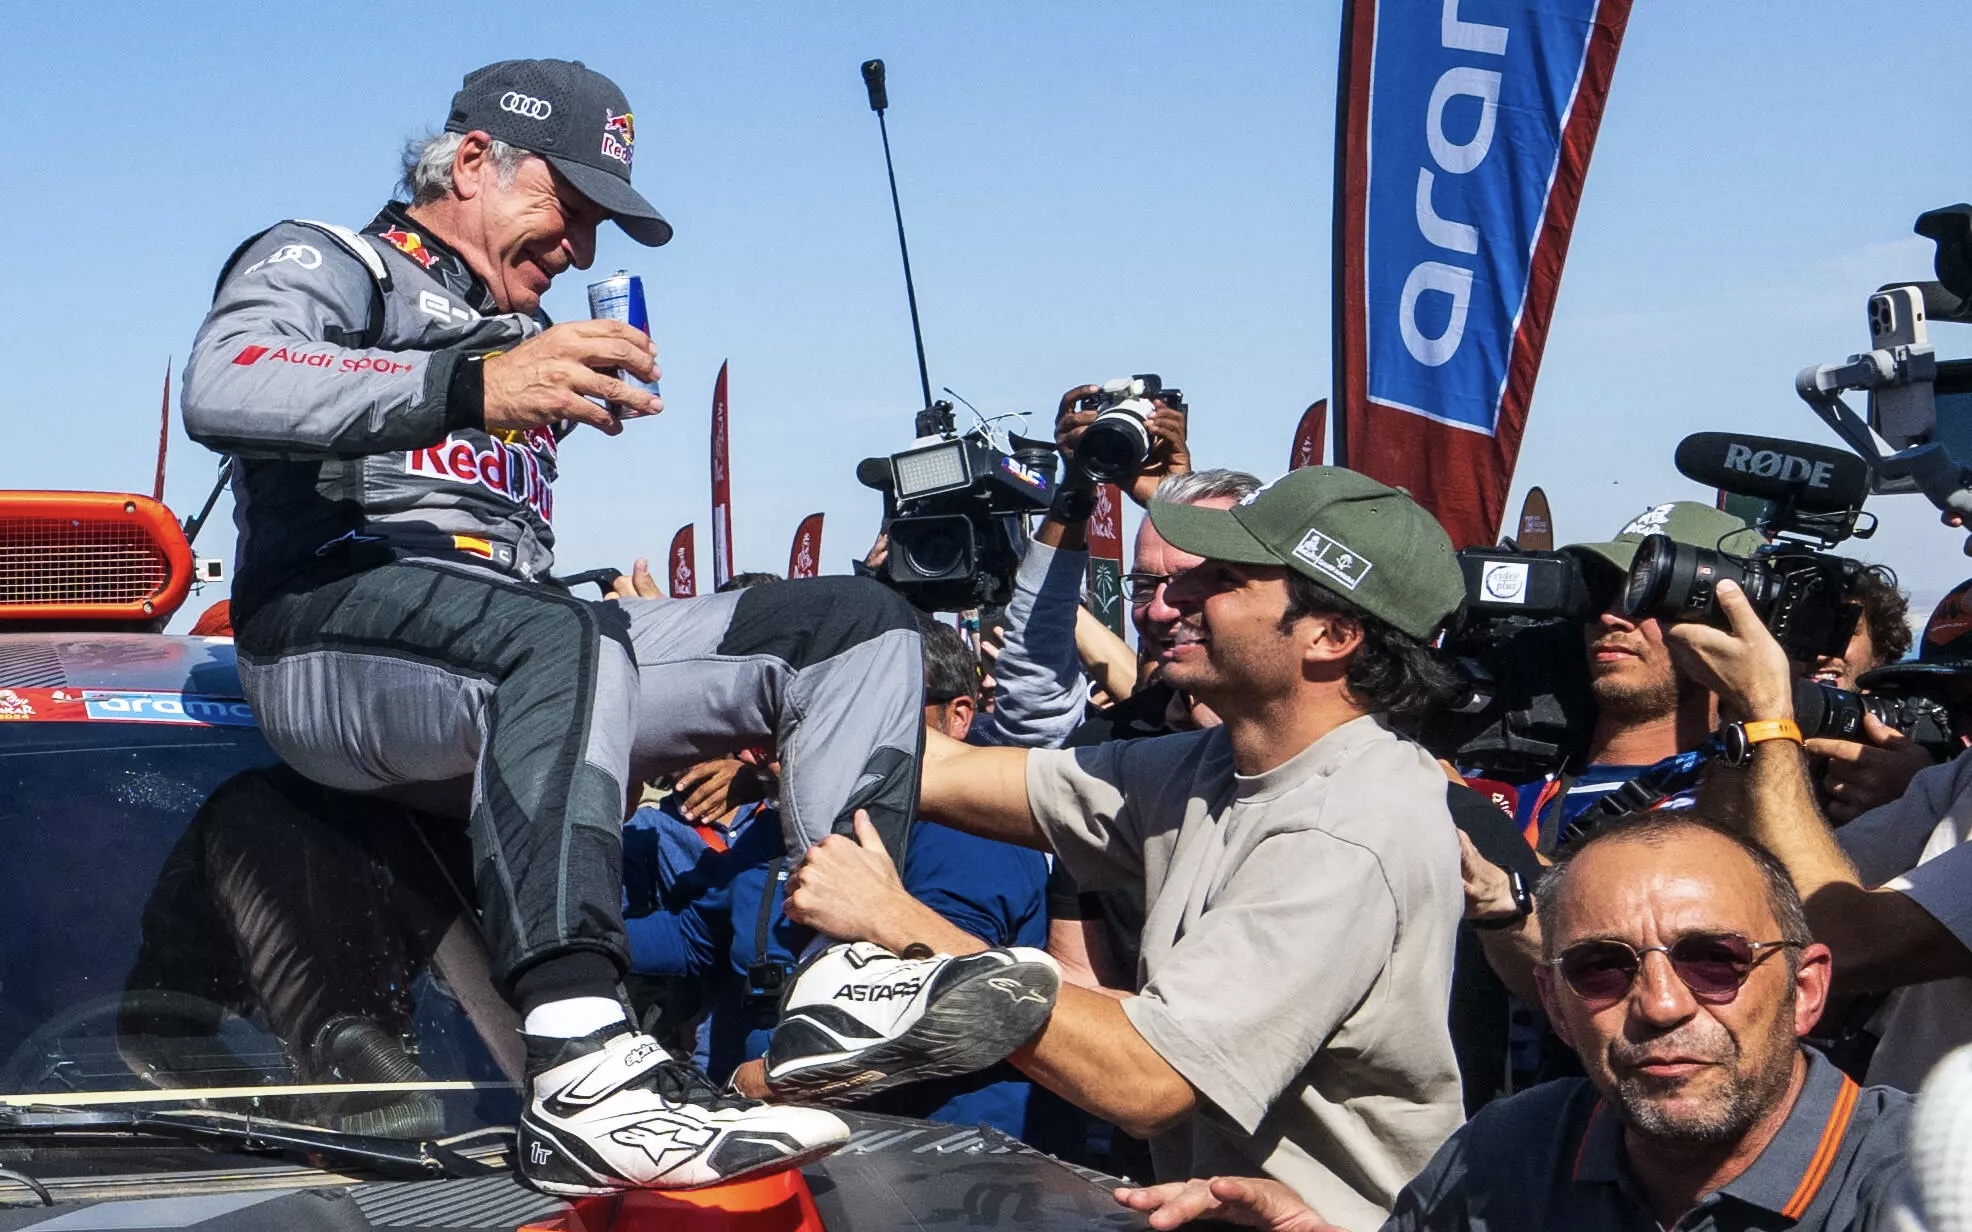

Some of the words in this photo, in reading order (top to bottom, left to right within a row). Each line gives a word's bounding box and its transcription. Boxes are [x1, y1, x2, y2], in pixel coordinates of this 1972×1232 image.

[268, 347, 334, 368] Audi
[405, 434, 513, 499] Red
[1723, 443, 1834, 488] RØDE
